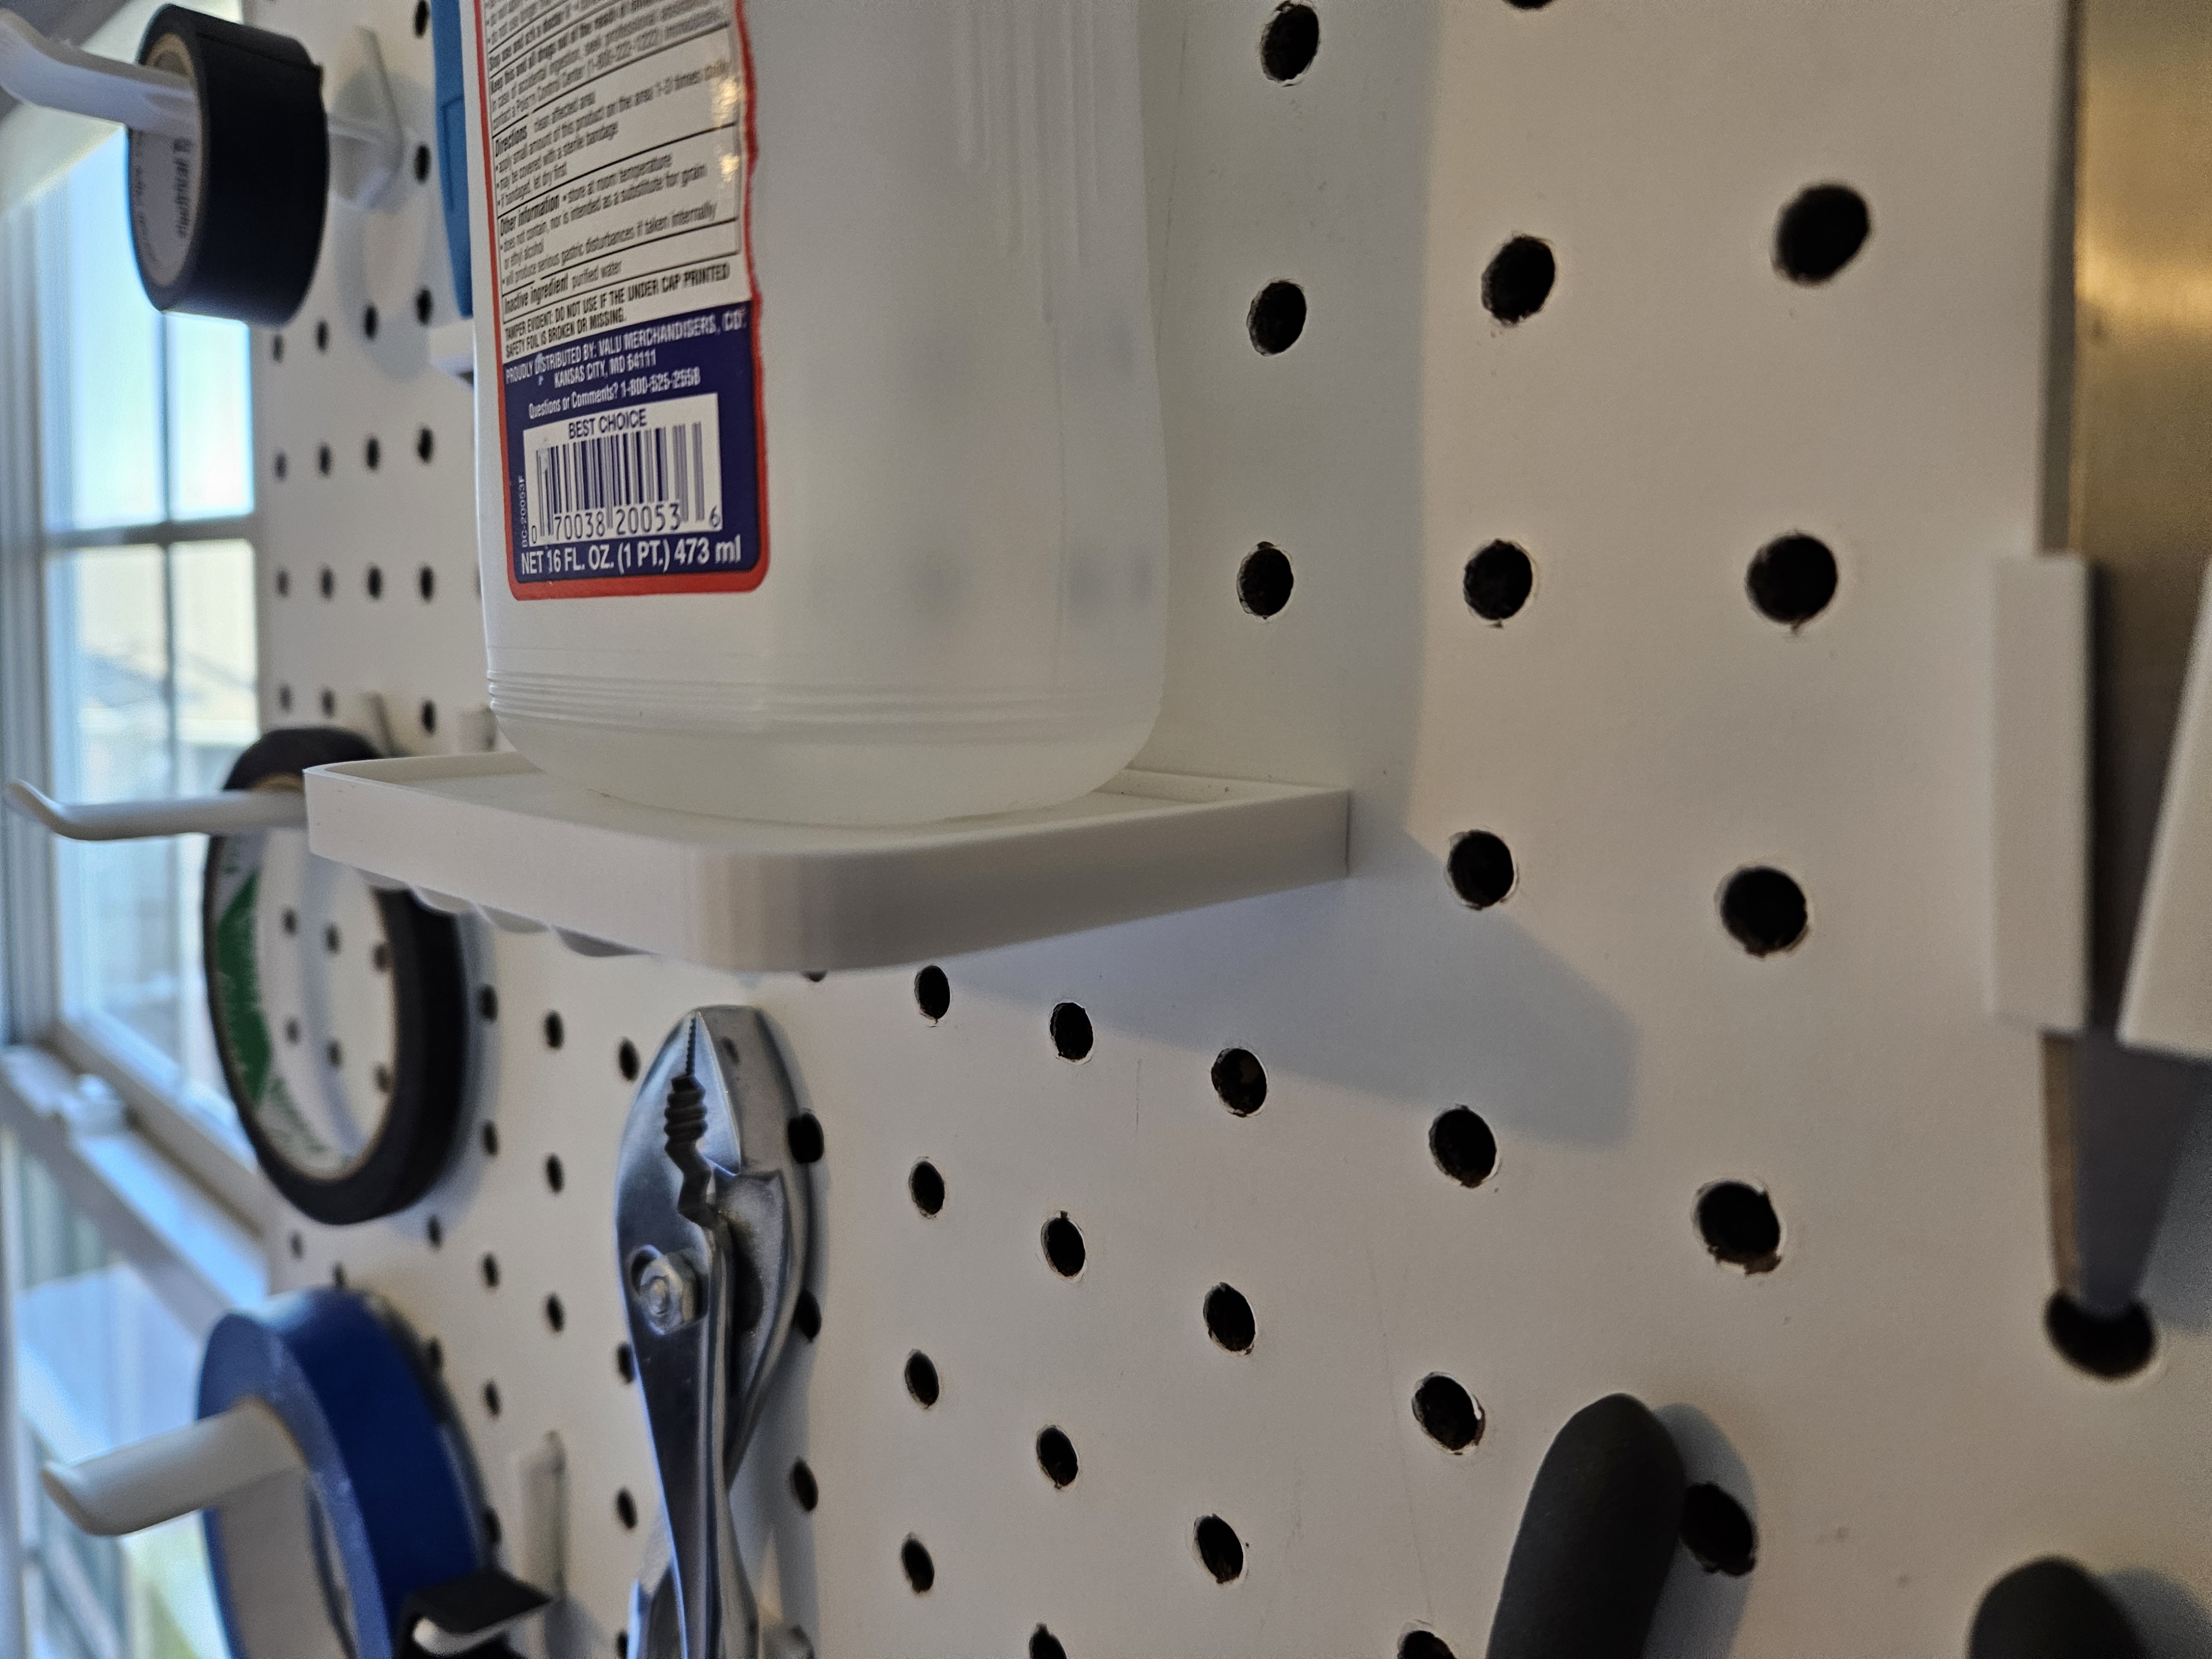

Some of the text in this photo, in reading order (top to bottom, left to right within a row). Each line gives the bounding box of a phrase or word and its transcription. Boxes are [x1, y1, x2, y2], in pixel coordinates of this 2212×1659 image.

[495, 126, 528, 158] Directions
[500, 216, 517, 237] Other
[518, 195, 560, 226] information
[504, 292, 529, 315] Inactive
[530, 273, 568, 305] ingredient
[504, 263, 730, 341] TAMPER EVIDENT: DO NOT USE IF THE UNDER CAP PRINTED
[505, 307, 624, 359] SAFETY FOIL IS BROKEN OR MISSING.
[505, 361, 533, 383] PROUDLY
[534, 346, 582, 374] DISTRIBUTED
[582, 342, 597, 361] BY:
[598, 335, 622, 356] VALU
[623, 316, 719, 349] MERCHANDISERS,
[554, 349, 656, 388] KANSAS CITY, MO 64111
[528, 399, 561, 419] Questions
[562, 397, 570, 411] or
[571, 382, 618, 408] Comments?
[568, 408, 647, 440] BEST CHOICE
[554, 511, 606, 541] 70038
[615, 503, 681, 536] 20053
[521, 533, 742, 575] NET 16 FL. OZ. (1 PT.) 473 ml
